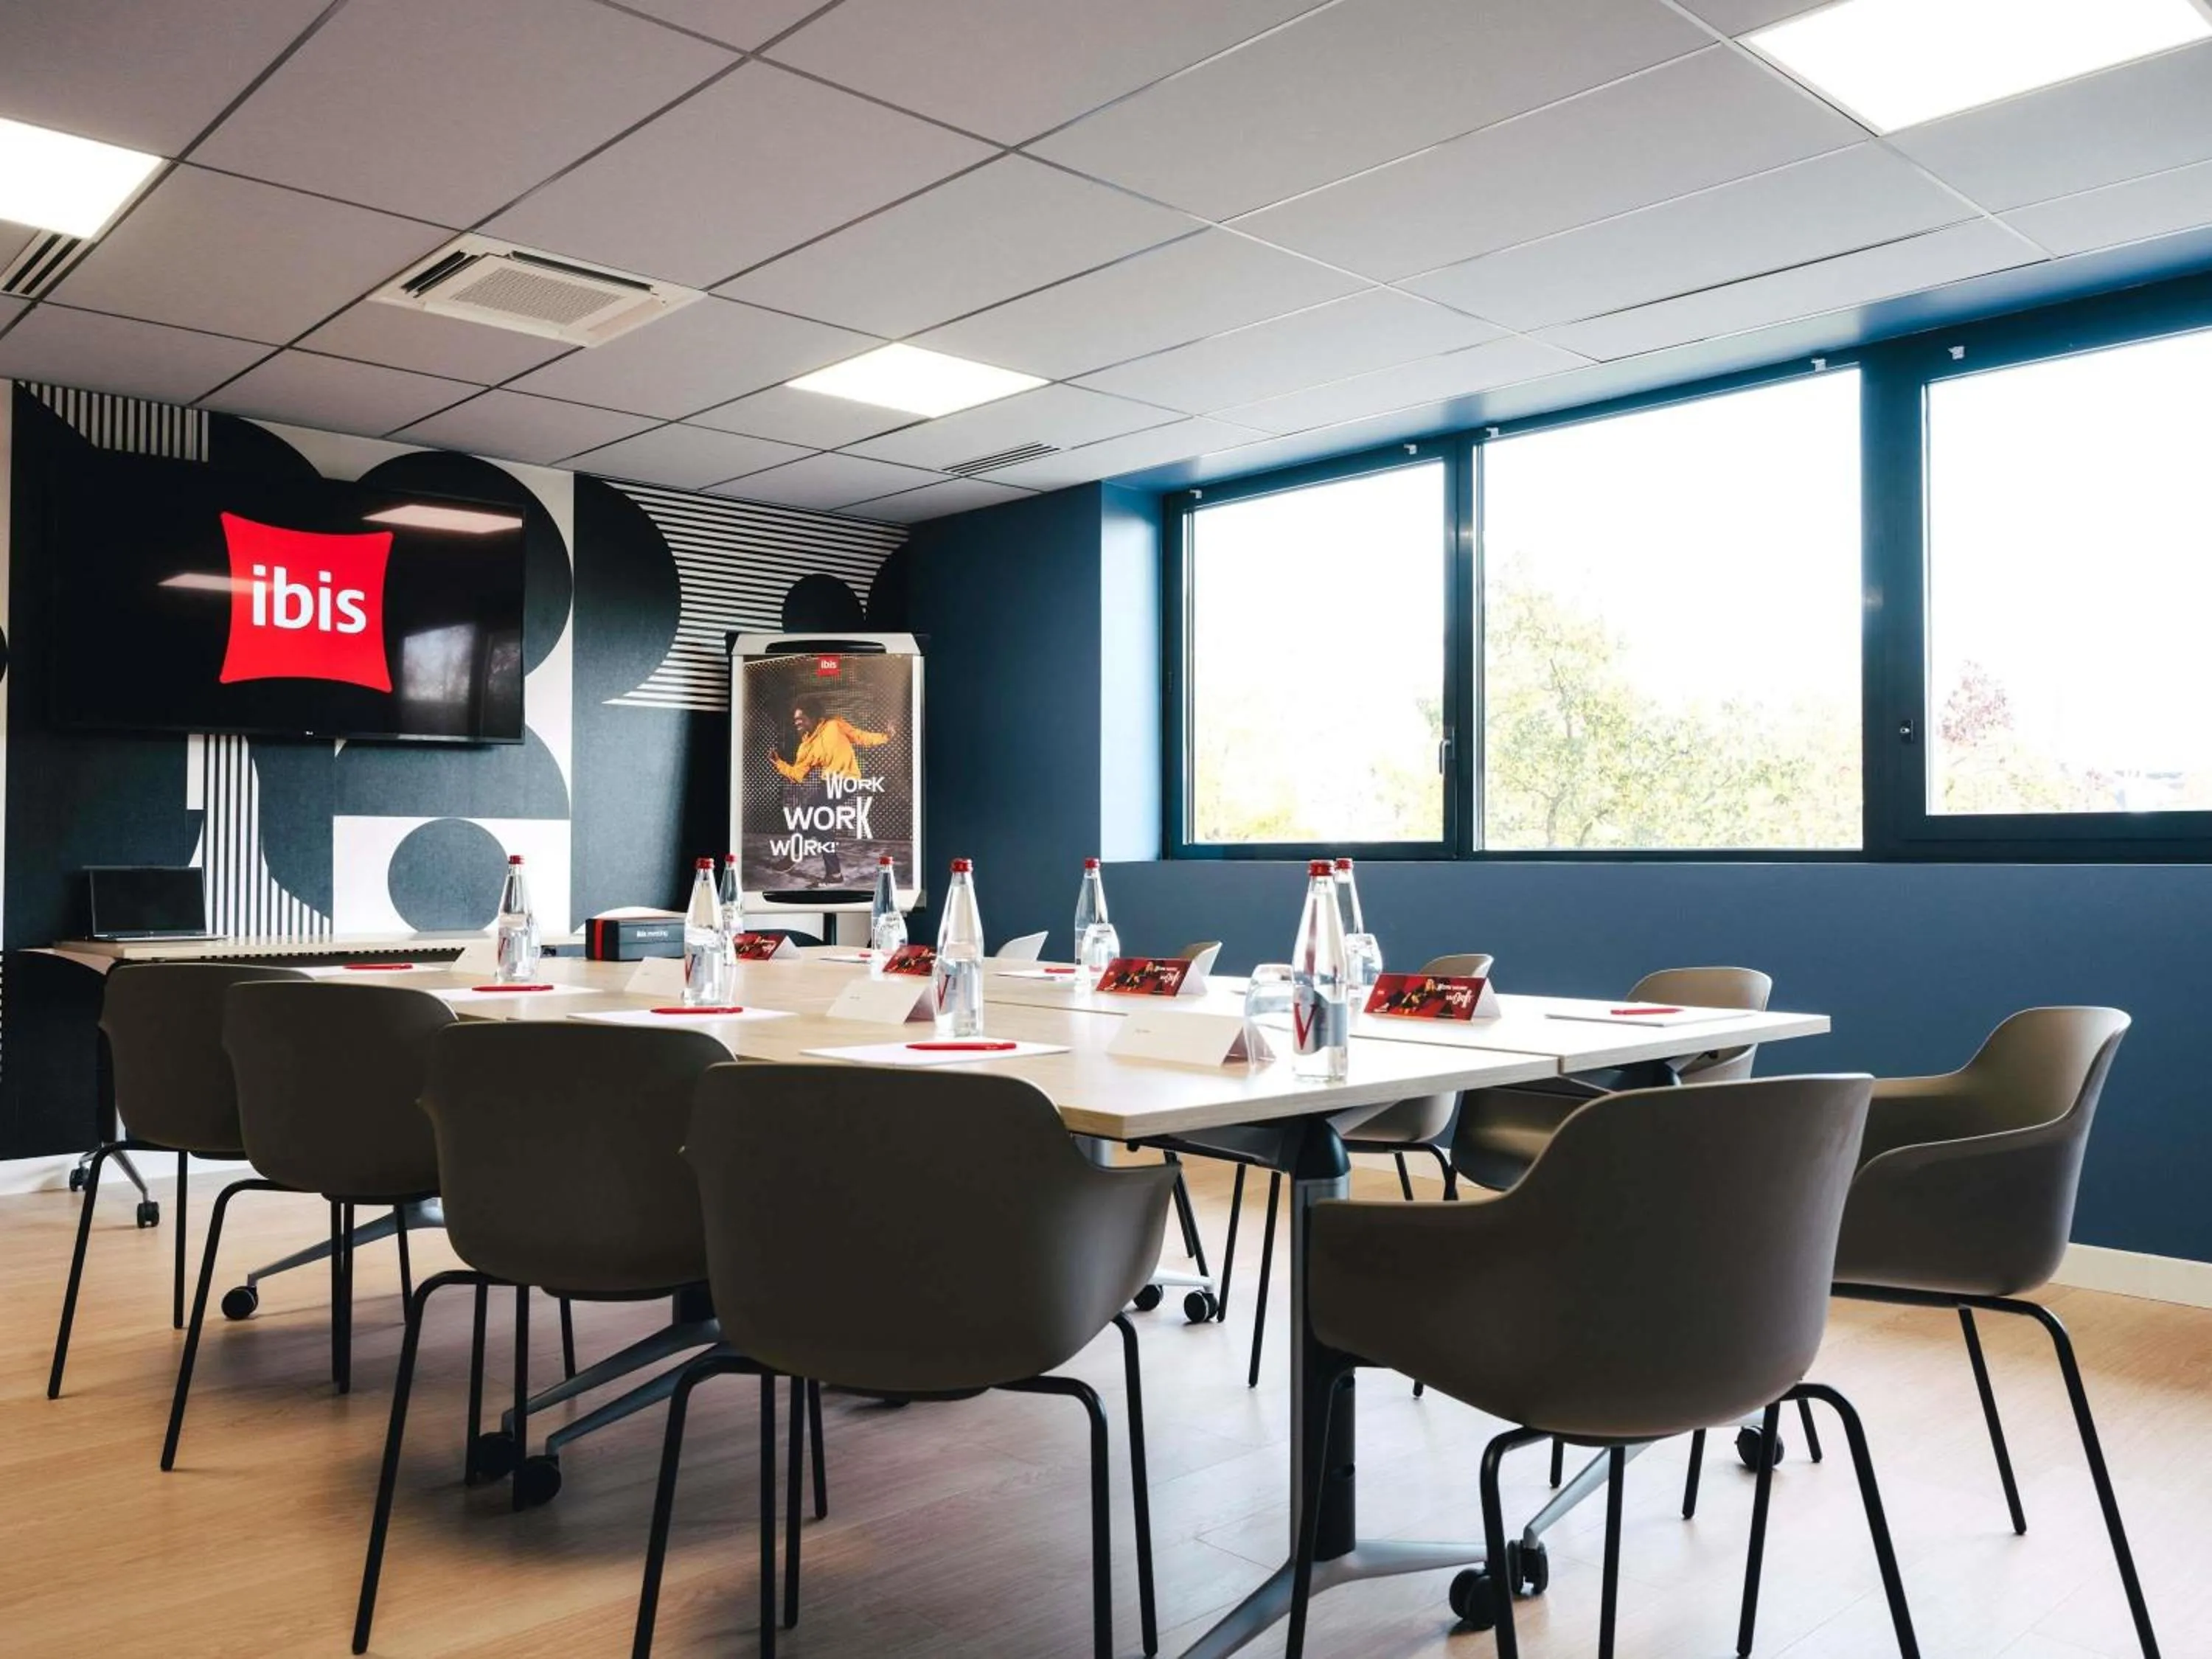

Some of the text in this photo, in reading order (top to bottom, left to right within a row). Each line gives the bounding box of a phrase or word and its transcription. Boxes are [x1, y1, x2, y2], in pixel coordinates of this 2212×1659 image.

[253, 564, 366, 634] ibis
[821, 660, 837, 669] ibis
[825, 771, 885, 799] WORK
[783, 796, 873, 840] WORK
